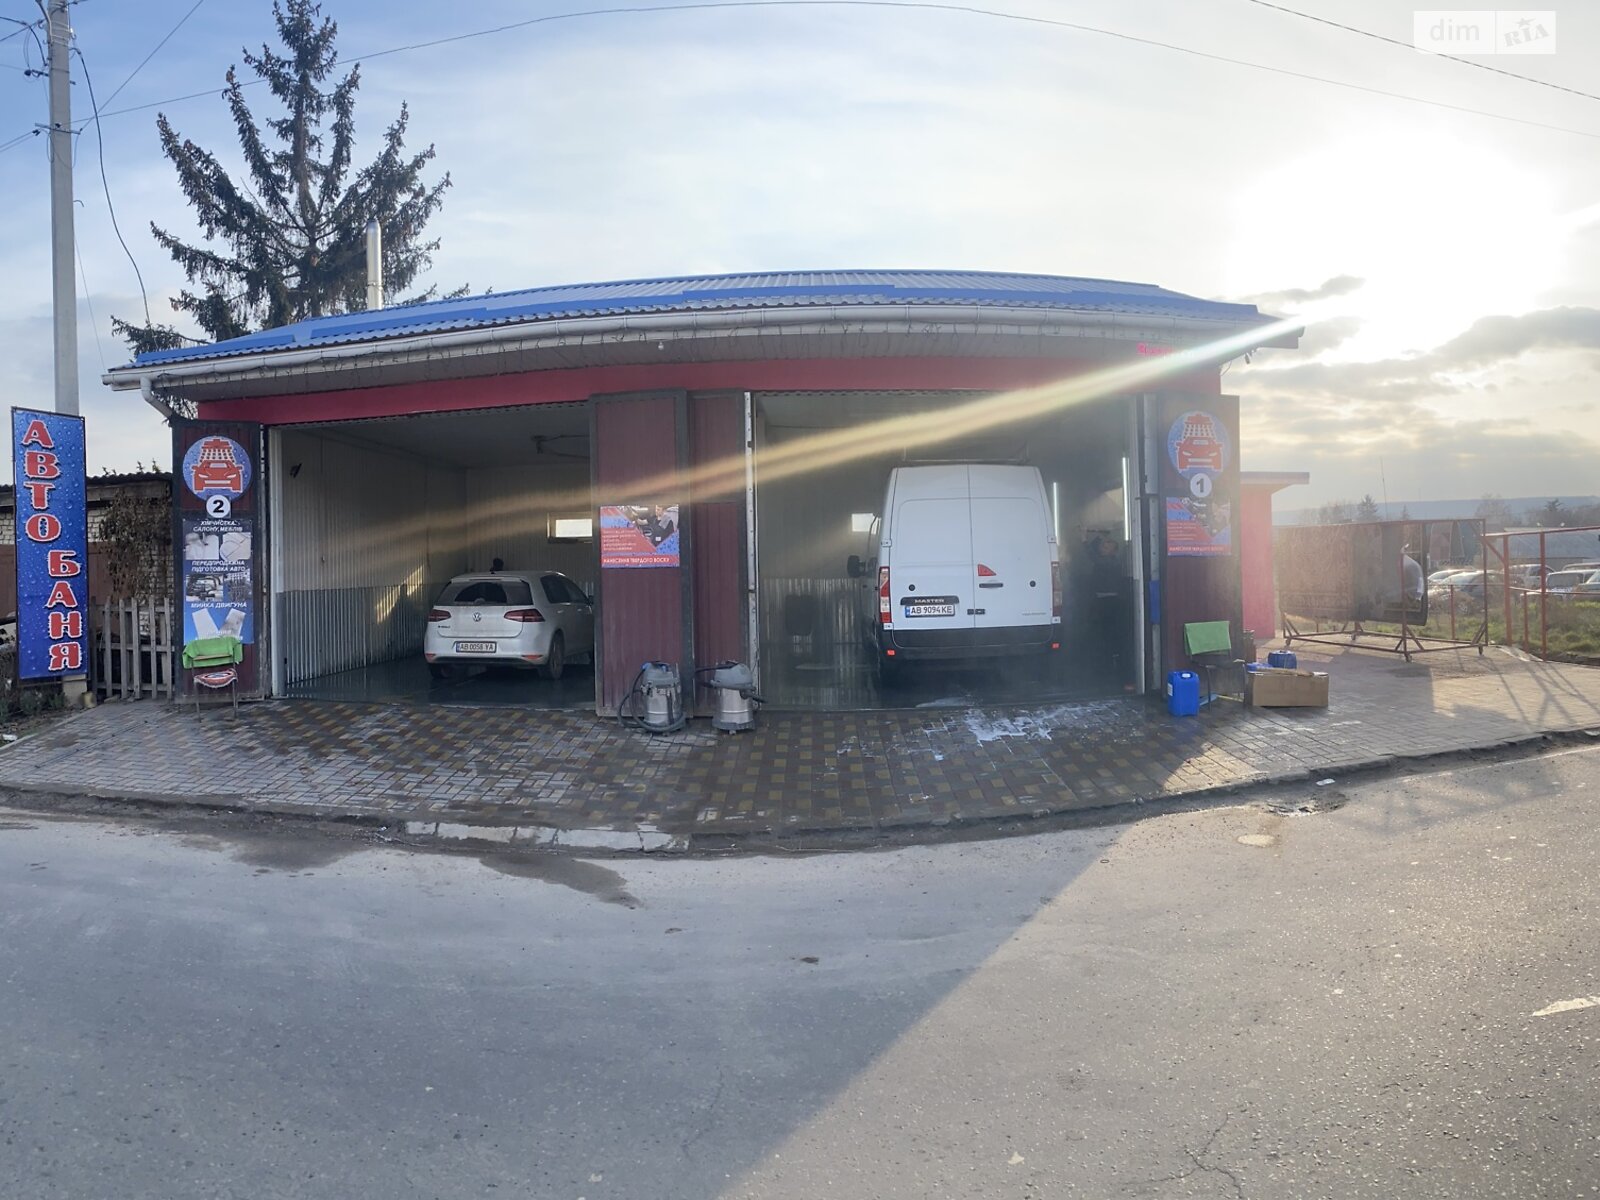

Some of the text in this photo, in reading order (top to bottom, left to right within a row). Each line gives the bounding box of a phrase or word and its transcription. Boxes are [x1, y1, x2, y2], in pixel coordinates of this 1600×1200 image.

[21, 419, 61, 543] АВТО
[1195, 478, 1205, 493] 1
[212, 499, 225, 513] 2
[45, 550, 81, 671] БАНЯ
[910, 606, 953, 614] AB 9094 KE
[460, 642, 469, 650] AB
